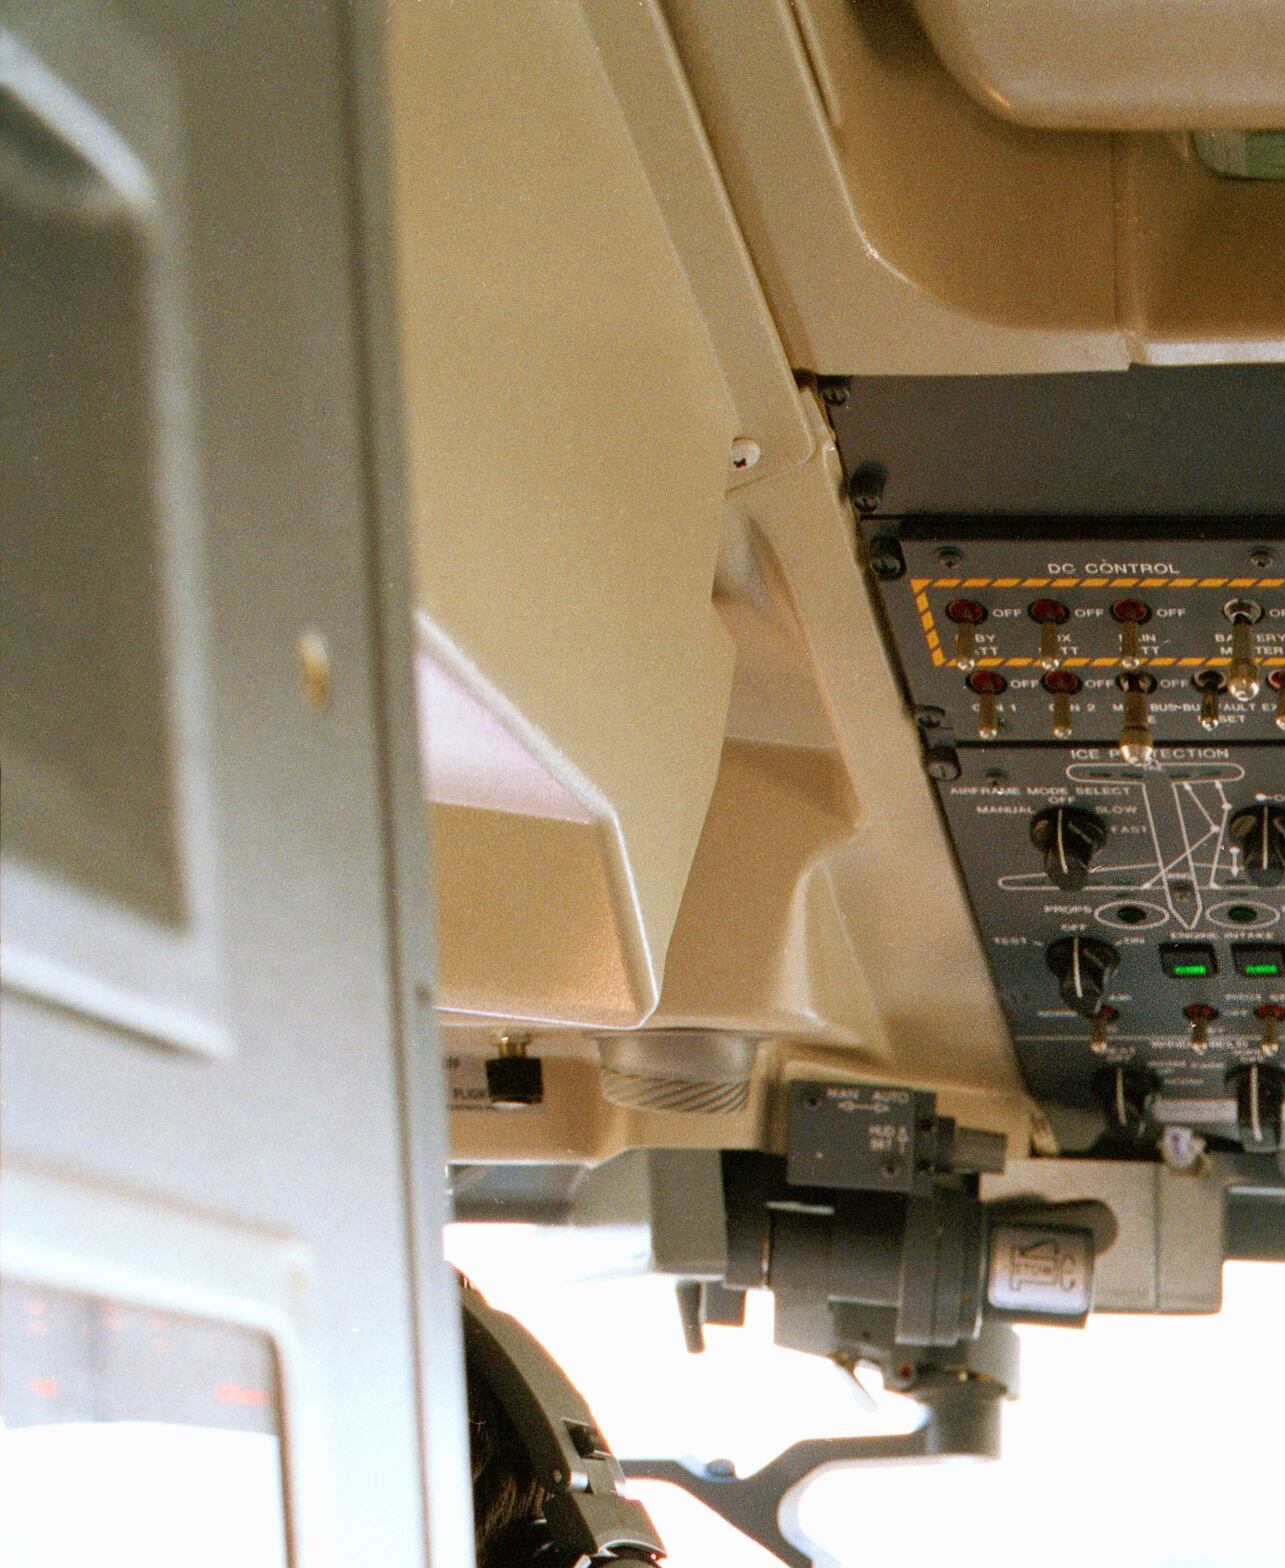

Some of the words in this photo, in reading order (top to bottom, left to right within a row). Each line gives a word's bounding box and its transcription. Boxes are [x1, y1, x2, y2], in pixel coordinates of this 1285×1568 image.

[1047, 563, 1074, 575] DC
[1084, 562, 1181, 575] CONTROL
[992, 608, 1022, 618] OFF
[1074, 608, 1105, 618] OFF
[1156, 608, 1187, 618] OFF
[1009, 679, 1041, 690] OFF
[1084, 679, 1116, 690] OFF
[1160, 679, 1190, 689] OFF
[1087, 702, 1095, 712] 2
[1070, 749, 1104, 760] ICE
[949, 786, 1020, 796] AIRFRAME
[1026, 786, 1071, 796] MODE
[1075, 786, 1131, 796] SELECT
[1048, 796, 1077, 804] OFF
[976, 805, 1036, 815] MANUAL
[1095, 805, 1138, 815] SLOW
[1110, 825, 1148, 835] FAST
